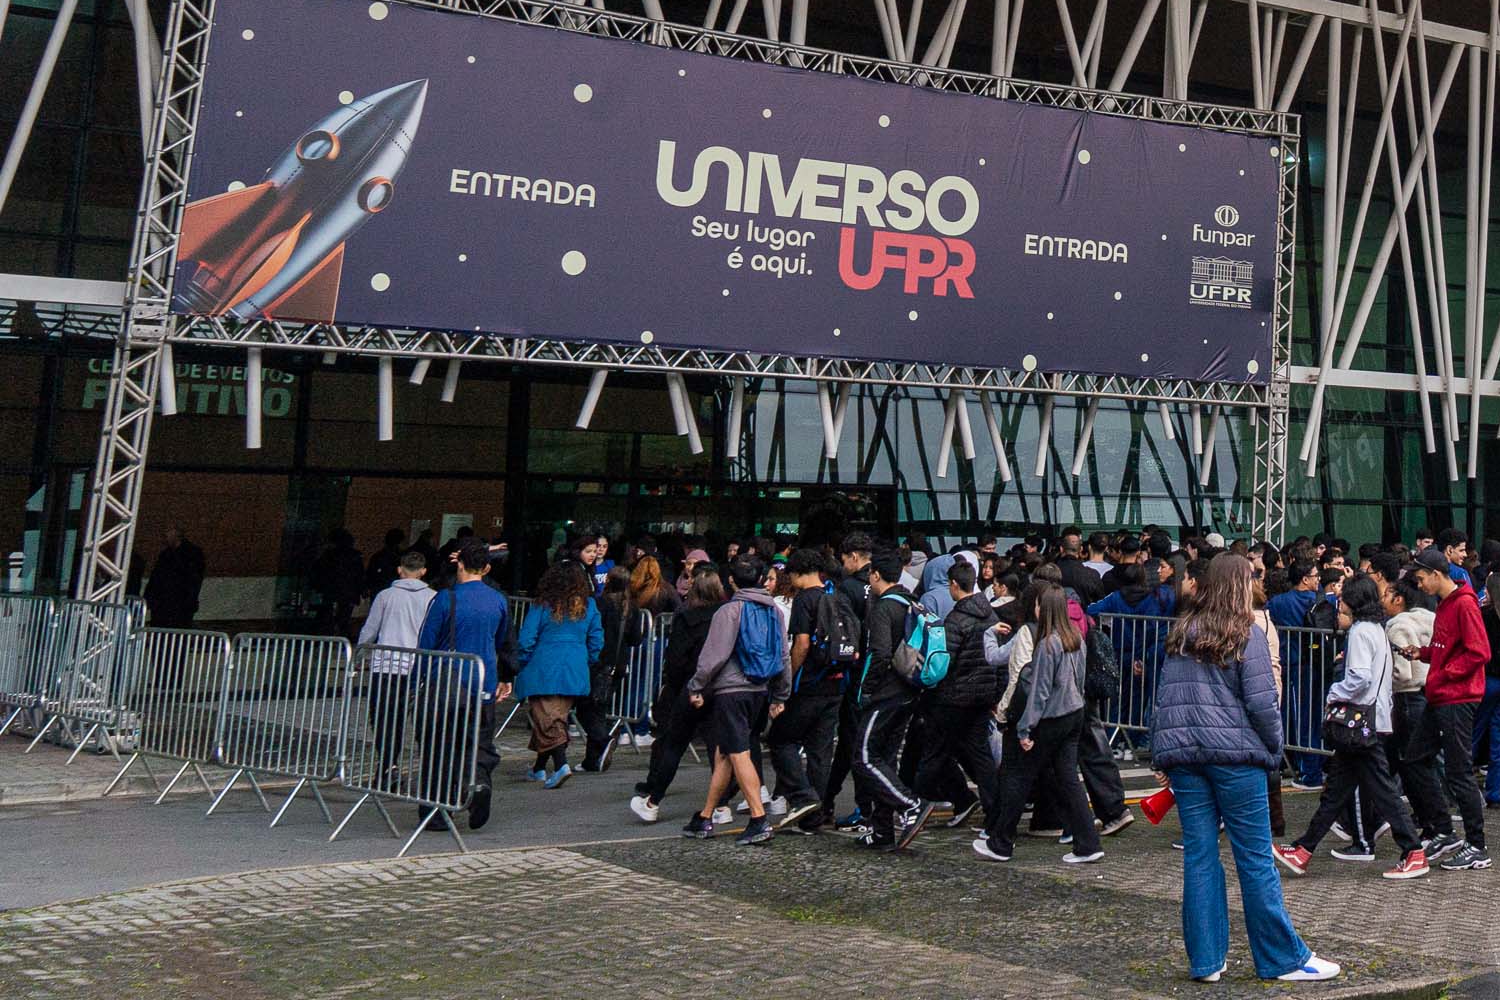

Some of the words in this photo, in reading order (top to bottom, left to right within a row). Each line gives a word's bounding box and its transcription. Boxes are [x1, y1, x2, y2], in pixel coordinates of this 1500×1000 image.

[449, 168, 596, 208] ENTRADA
[655, 139, 980, 236] UNIVERSO
[691, 215, 740, 240] Seu
[746, 219, 816, 251] lugar
[1024, 234, 1128, 264] ENTRADA
[1192, 223, 1256, 248] funpar
[726, 246, 744, 269] é
[750, 252, 813, 279] aqui.
[838, 226, 977, 299] UFPR
[1189, 283, 1253, 303] UFPR
